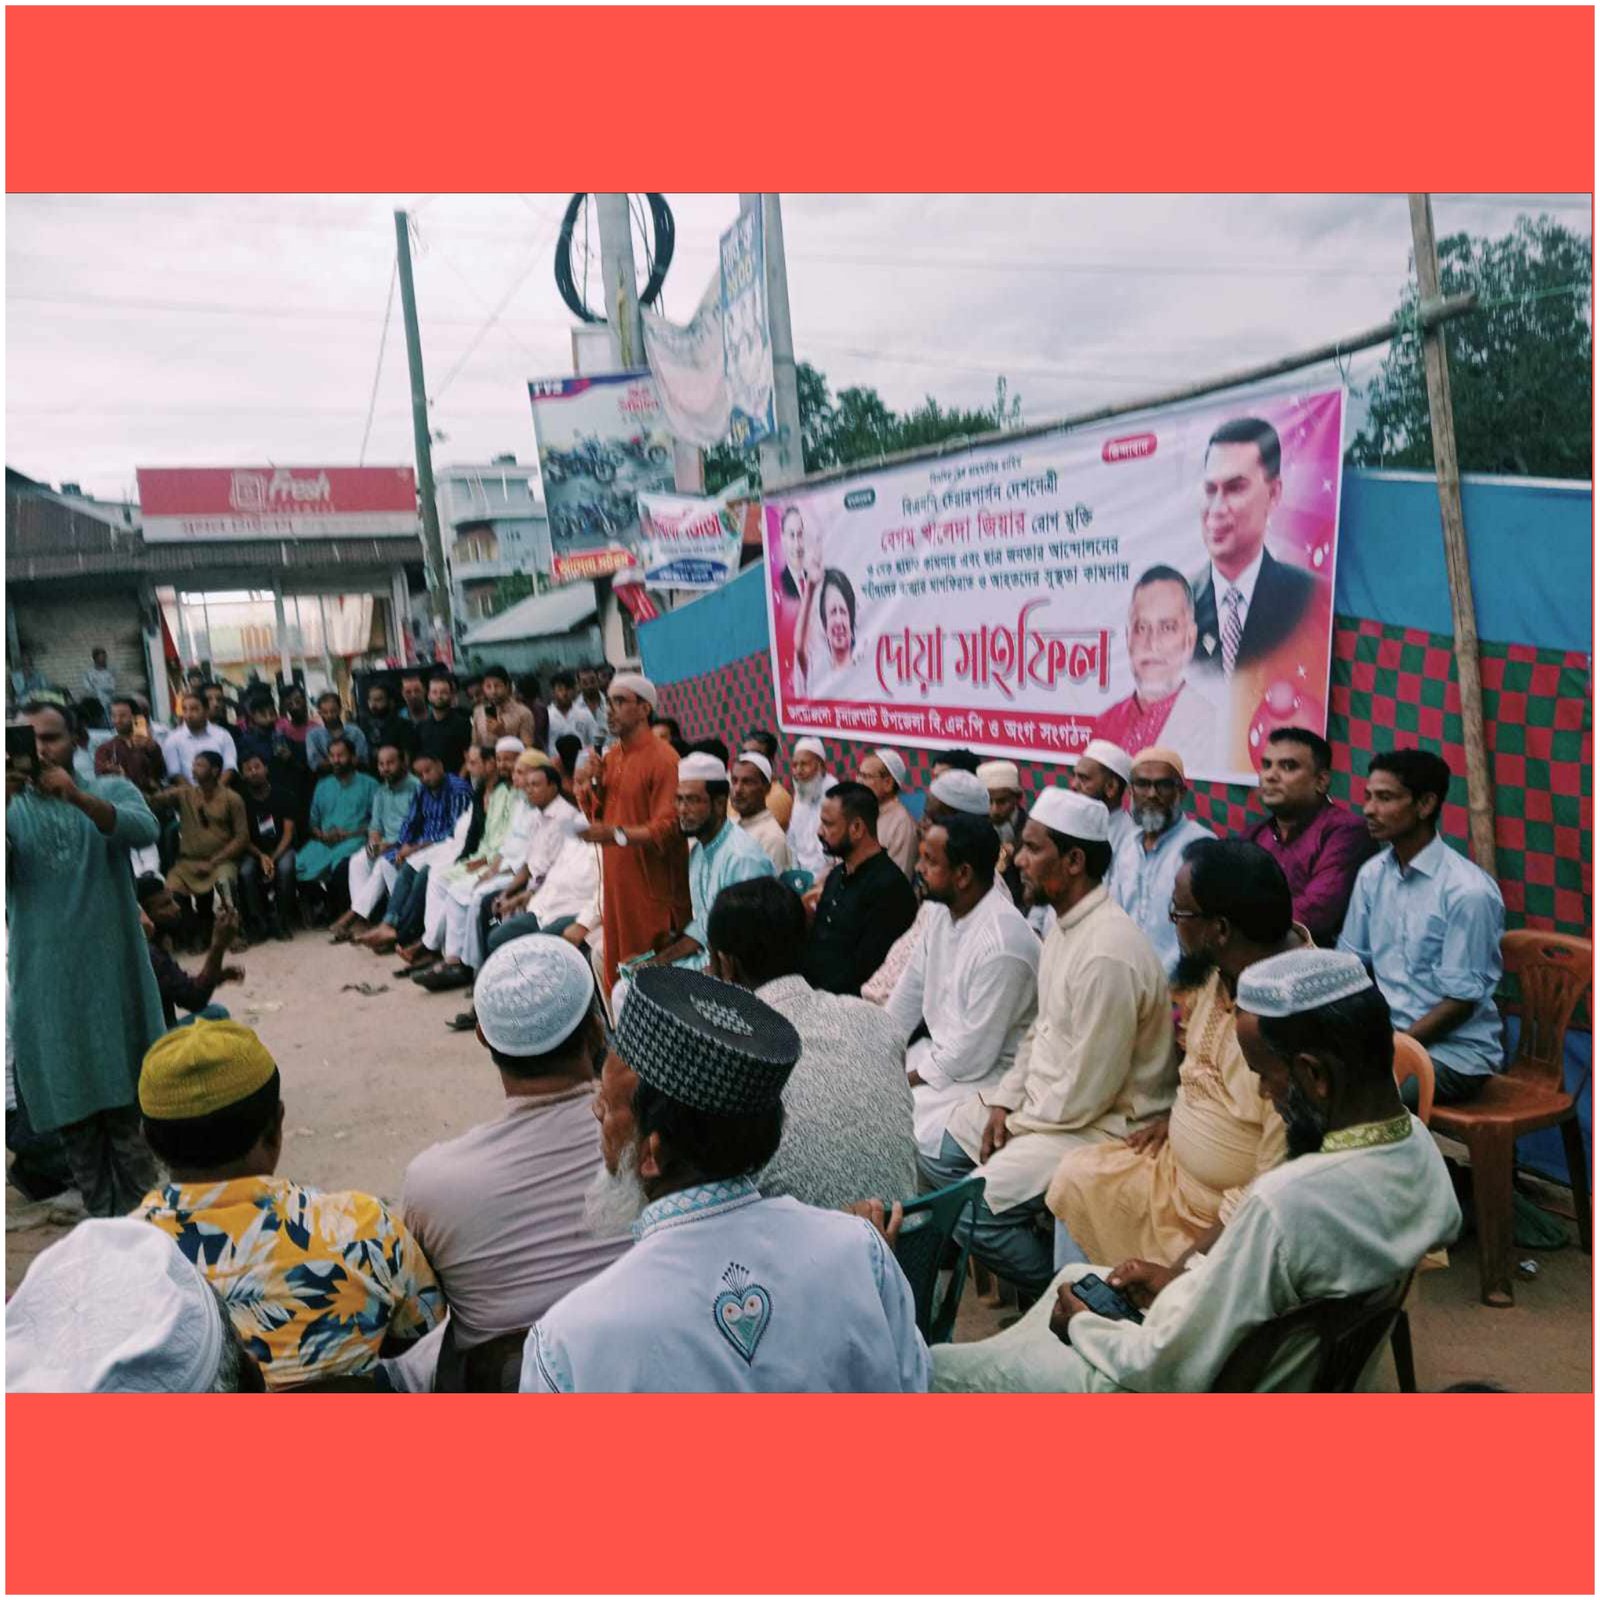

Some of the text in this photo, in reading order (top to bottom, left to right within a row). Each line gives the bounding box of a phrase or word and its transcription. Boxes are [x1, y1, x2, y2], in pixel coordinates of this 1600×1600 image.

[268, 467, 332, 502] Fresh
[1006, 468, 1058, 500] দেশনেত্রী
[881, 501, 1094, 553] বেগম খালেদা জিয়ার রোগ মুক্তি
[960, 551, 980, 569] এবং
[983, 547, 1003, 568] ছাত্র
[1006, 543, 1045, 564] জনতার
[1048, 536, 1119, 561] আন্দোলনের
[978, 574, 986, 590] ও
[990, 568, 1040, 592] আহতদের
[1044, 564, 1079, 591] সুস্থতা
[1082, 560, 1130, 584] কামনায়
[876, 598, 1112, 701] দোয়া মাহফিল
[880, 705, 925, 734] উপজেলা
[928, 708, 984, 739] বি.এন.পি
[988, 719, 1000, 738] ও
[1003, 719, 1036, 746] অংগ
[1038, 715, 1093, 749] সংগঠন
